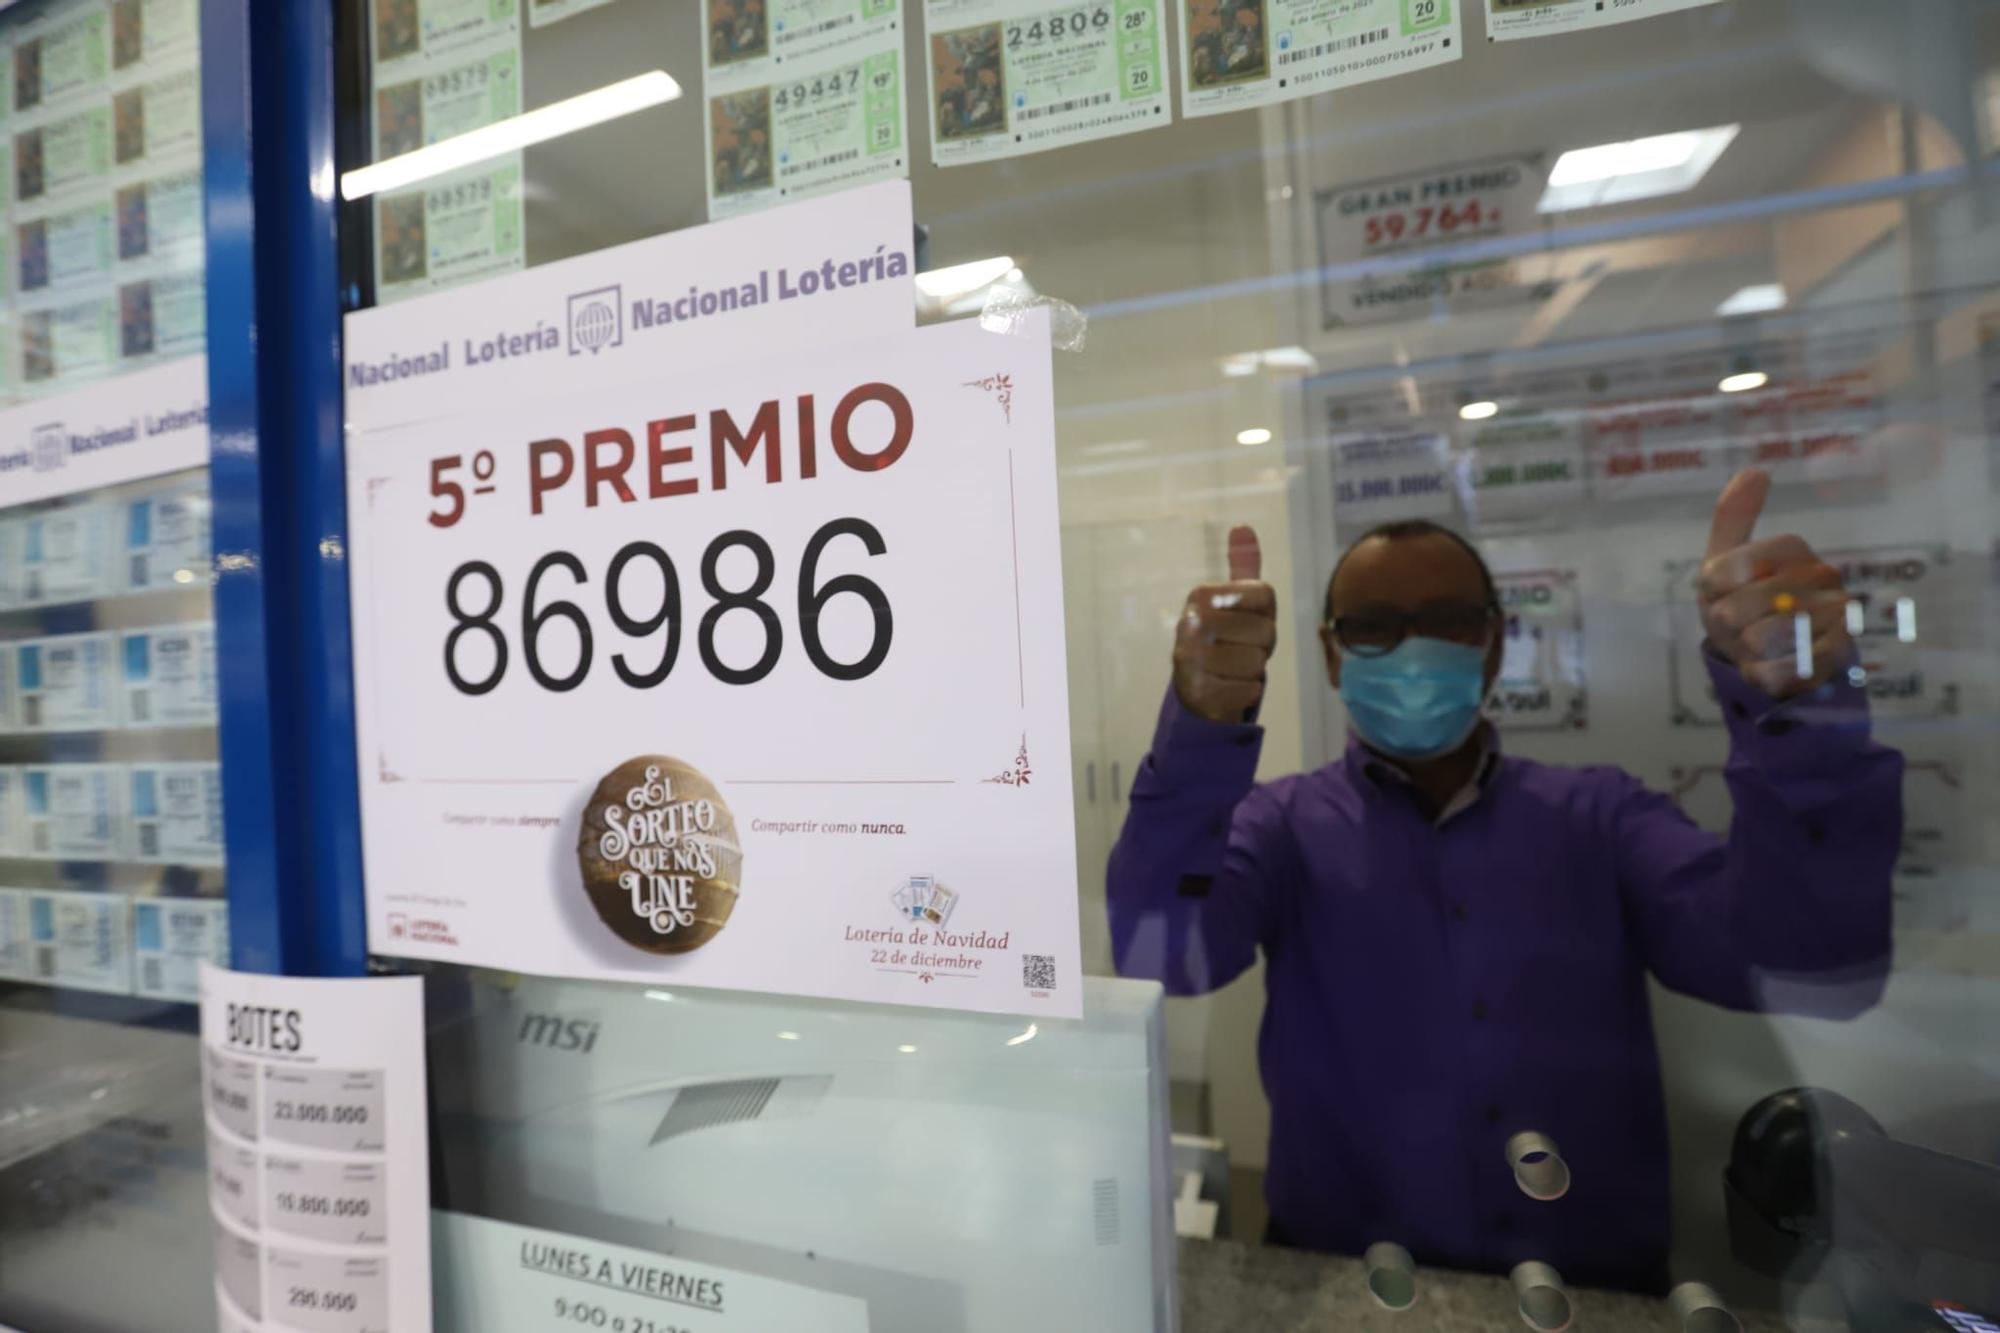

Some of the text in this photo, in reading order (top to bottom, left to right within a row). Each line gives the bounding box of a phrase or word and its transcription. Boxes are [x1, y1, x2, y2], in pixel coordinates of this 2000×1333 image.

[1007, 7, 1109, 48] 24806
[1415, 1, 1435, 17] 20
[1131, 70, 1149, 85] 20
[349, 244, 909, 389] Nacional Lotería Nacional Lotería
[427, 382, 914, 529] 5º PREMIO
[444, 517, 894, 697] 86986
[600, 798, 716, 862] SORTEO
[751, 817, 907, 836] Compartir como nunca.
[629, 837, 716, 879] QUE NOS
[844, 924, 1010, 951] Lotería de Navidad
[870, 948, 984, 970] 22 de diciembre
[227, 1002, 303, 1052] BOTES
[517, 1011, 602, 1054] msi
[520, 1240, 725, 1308] LUNES A VIERNES
